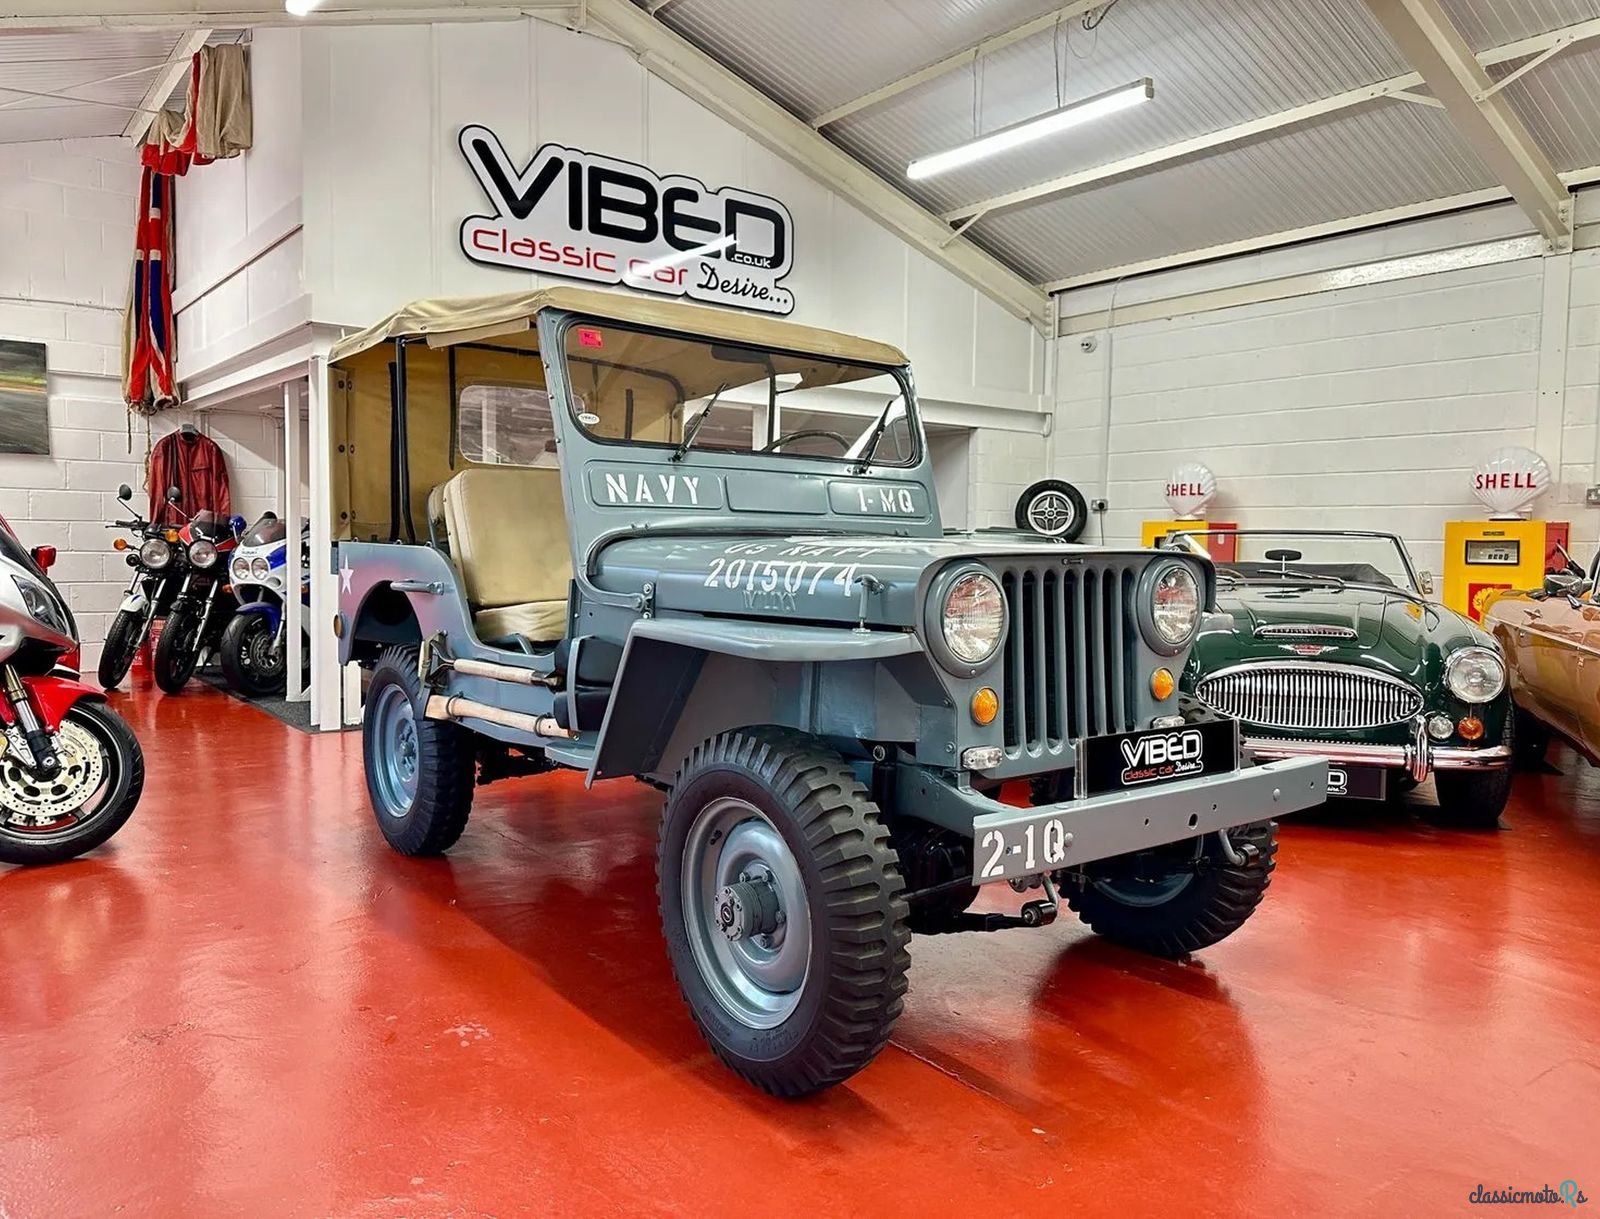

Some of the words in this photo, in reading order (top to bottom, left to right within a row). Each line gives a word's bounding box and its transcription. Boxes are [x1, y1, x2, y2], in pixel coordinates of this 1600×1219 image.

[472, 138, 785, 269] VIBED
[730, 253, 771, 268] .co.uk
[697, 262, 788, 304] Desire...
[605, 473, 699, 504] NAVY
[1166, 483, 1205, 496] SHELL
[1476, 472, 1537, 489] SHELL
[724, 543, 777, 554] US
[704, 558, 859, 597] 2015074
[1123, 734, 1200, 767] VIBED
[981, 819, 1065, 878] 2-1Q
